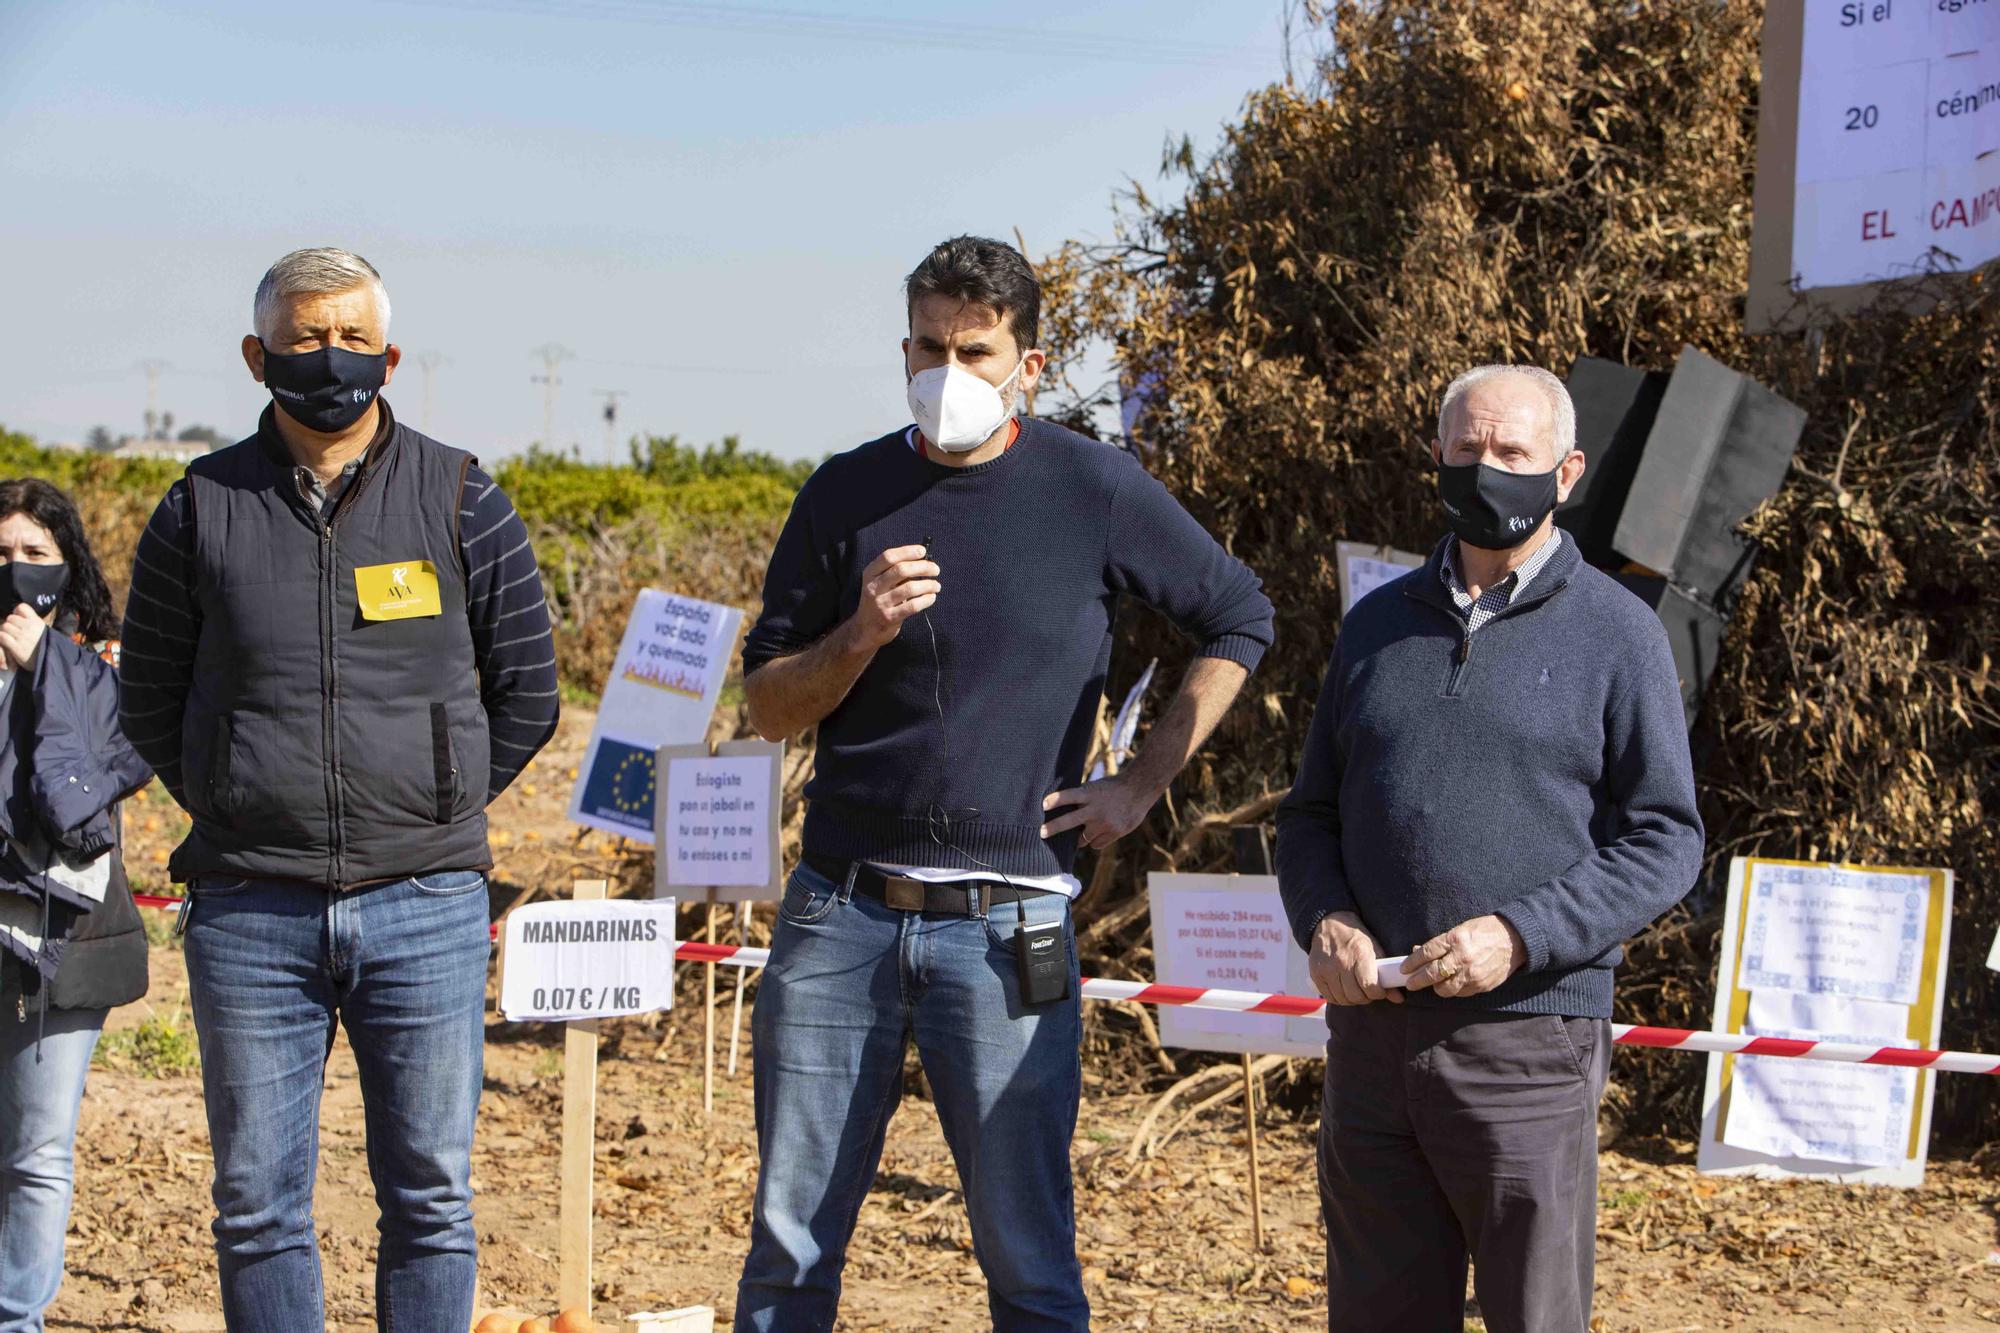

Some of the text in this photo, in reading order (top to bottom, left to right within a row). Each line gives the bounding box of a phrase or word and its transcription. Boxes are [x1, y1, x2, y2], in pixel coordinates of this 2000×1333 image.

[1841, 0, 1891, 27] Si el
[1845, 105, 1878, 131] 20
[1862, 210, 1896, 241] EL
[712, 826, 719, 840] y
[723, 826, 737, 837] no
[522, 919, 658, 943] MANDARINAS
[613, 987, 641, 1010] KG
